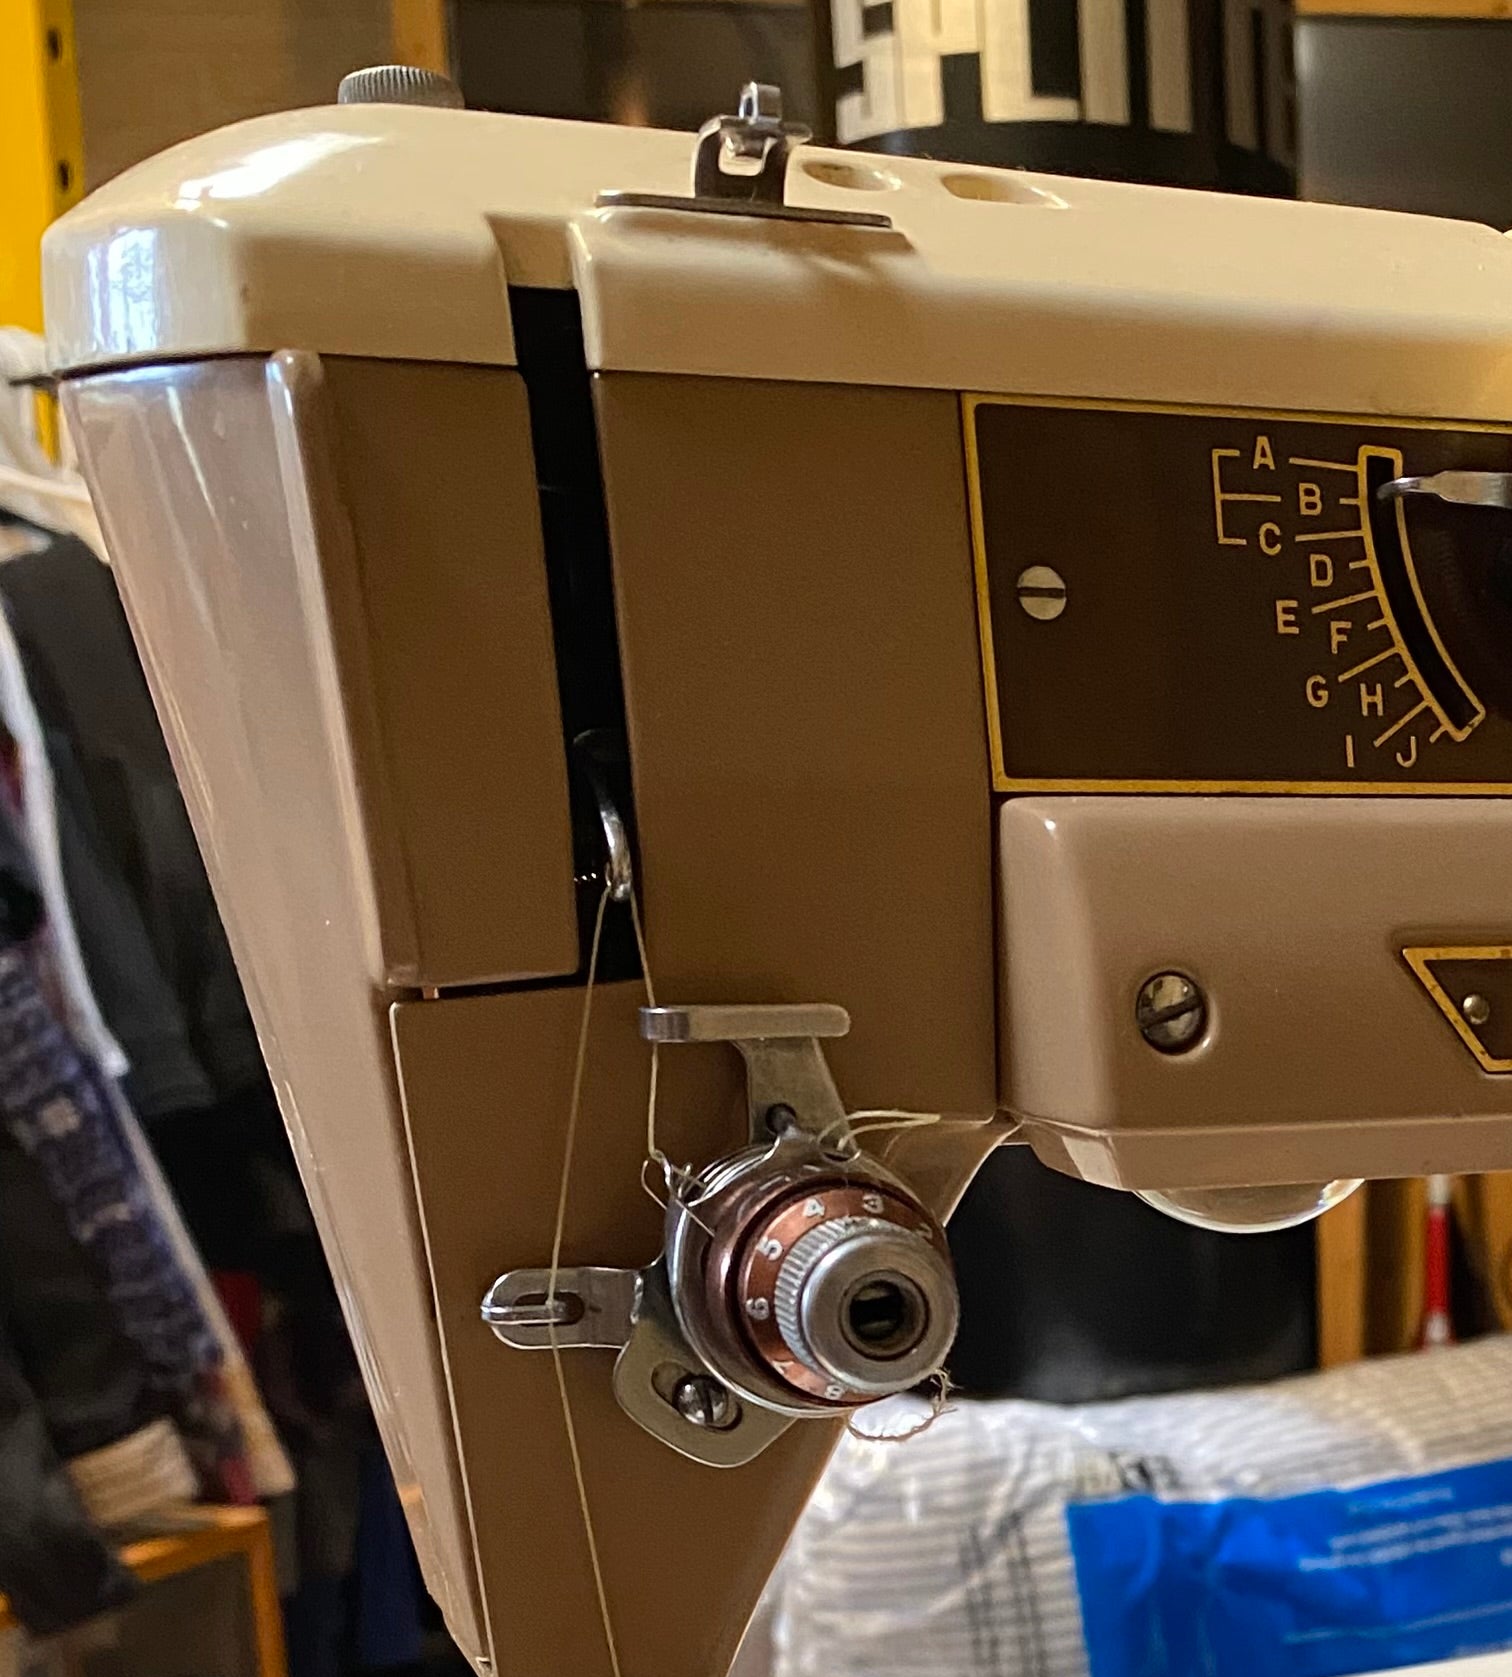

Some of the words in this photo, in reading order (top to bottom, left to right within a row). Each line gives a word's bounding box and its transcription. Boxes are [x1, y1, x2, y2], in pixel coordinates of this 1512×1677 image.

[1253, 436, 1275, 470] A
[1299, 483, 1322, 515] B
[1258, 522, 1281, 555] C
[1310, 554, 1333, 587] D
[1276, 600, 1299, 634] E
[1330, 621, 1352, 654] F
[1306, 675, 1329, 708] G
[1360, 683, 1383, 716] H
[1346, 735, 1355, 768] I
[1396, 736, 1417, 768] J
[803, 1198, 825, 1217] 4
[862, 1194, 884, 1214] 3
[757, 1236, 783, 1261] 5
[745, 1297, 769, 1320] 6
